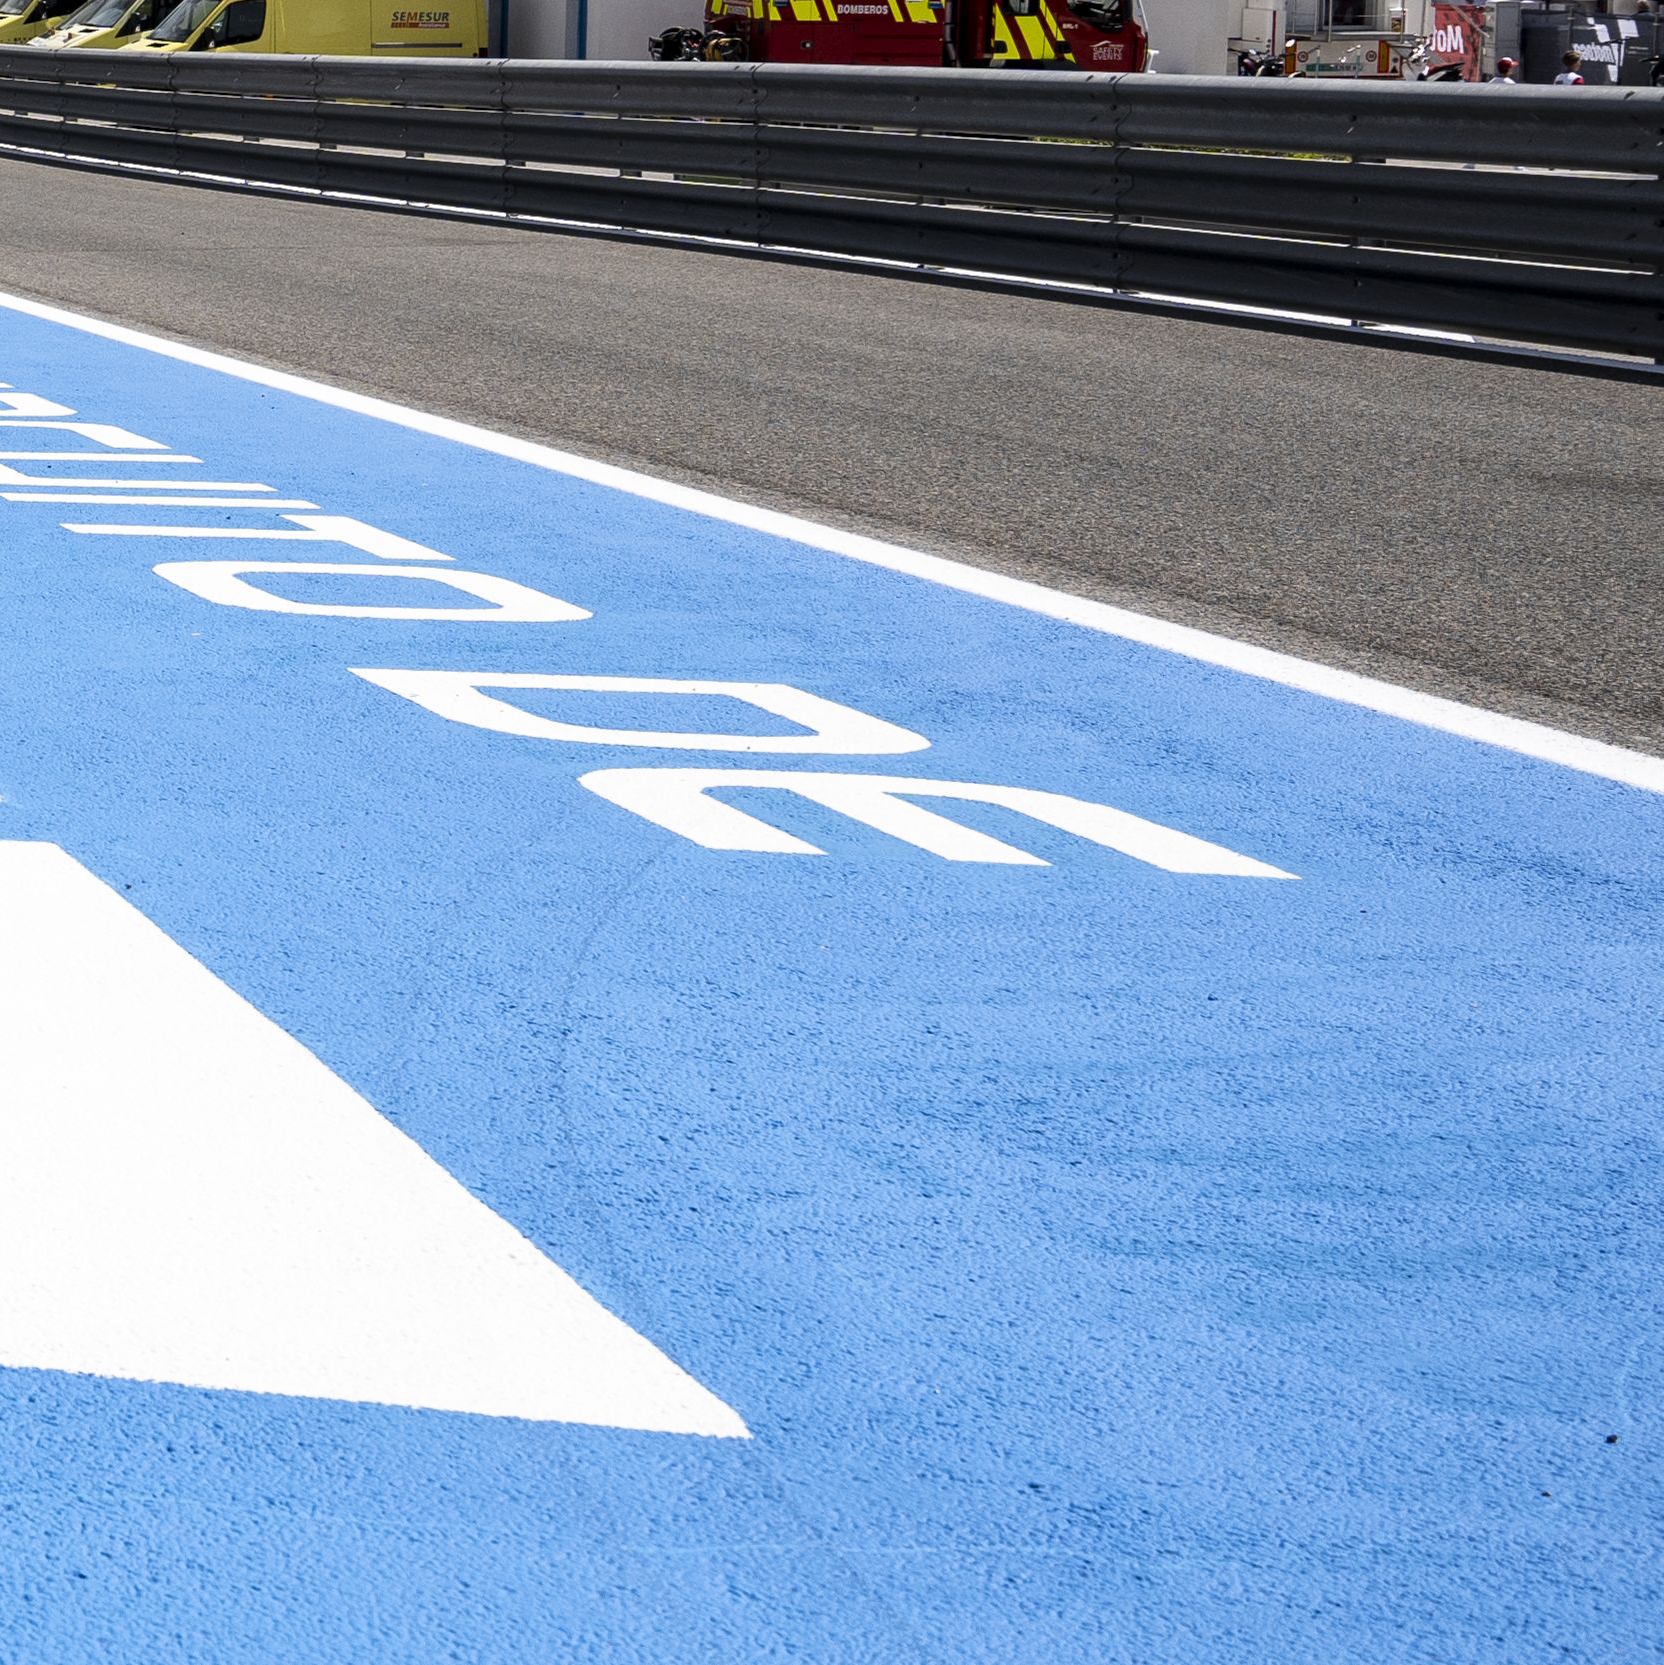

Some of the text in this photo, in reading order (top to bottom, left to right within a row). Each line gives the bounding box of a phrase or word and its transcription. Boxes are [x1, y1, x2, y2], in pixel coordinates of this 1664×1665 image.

[837, 4, 889, 15] BOMBEROS
[391, 11, 450, 22] SEMESUR
[347, 668, 1302, 879] DE
